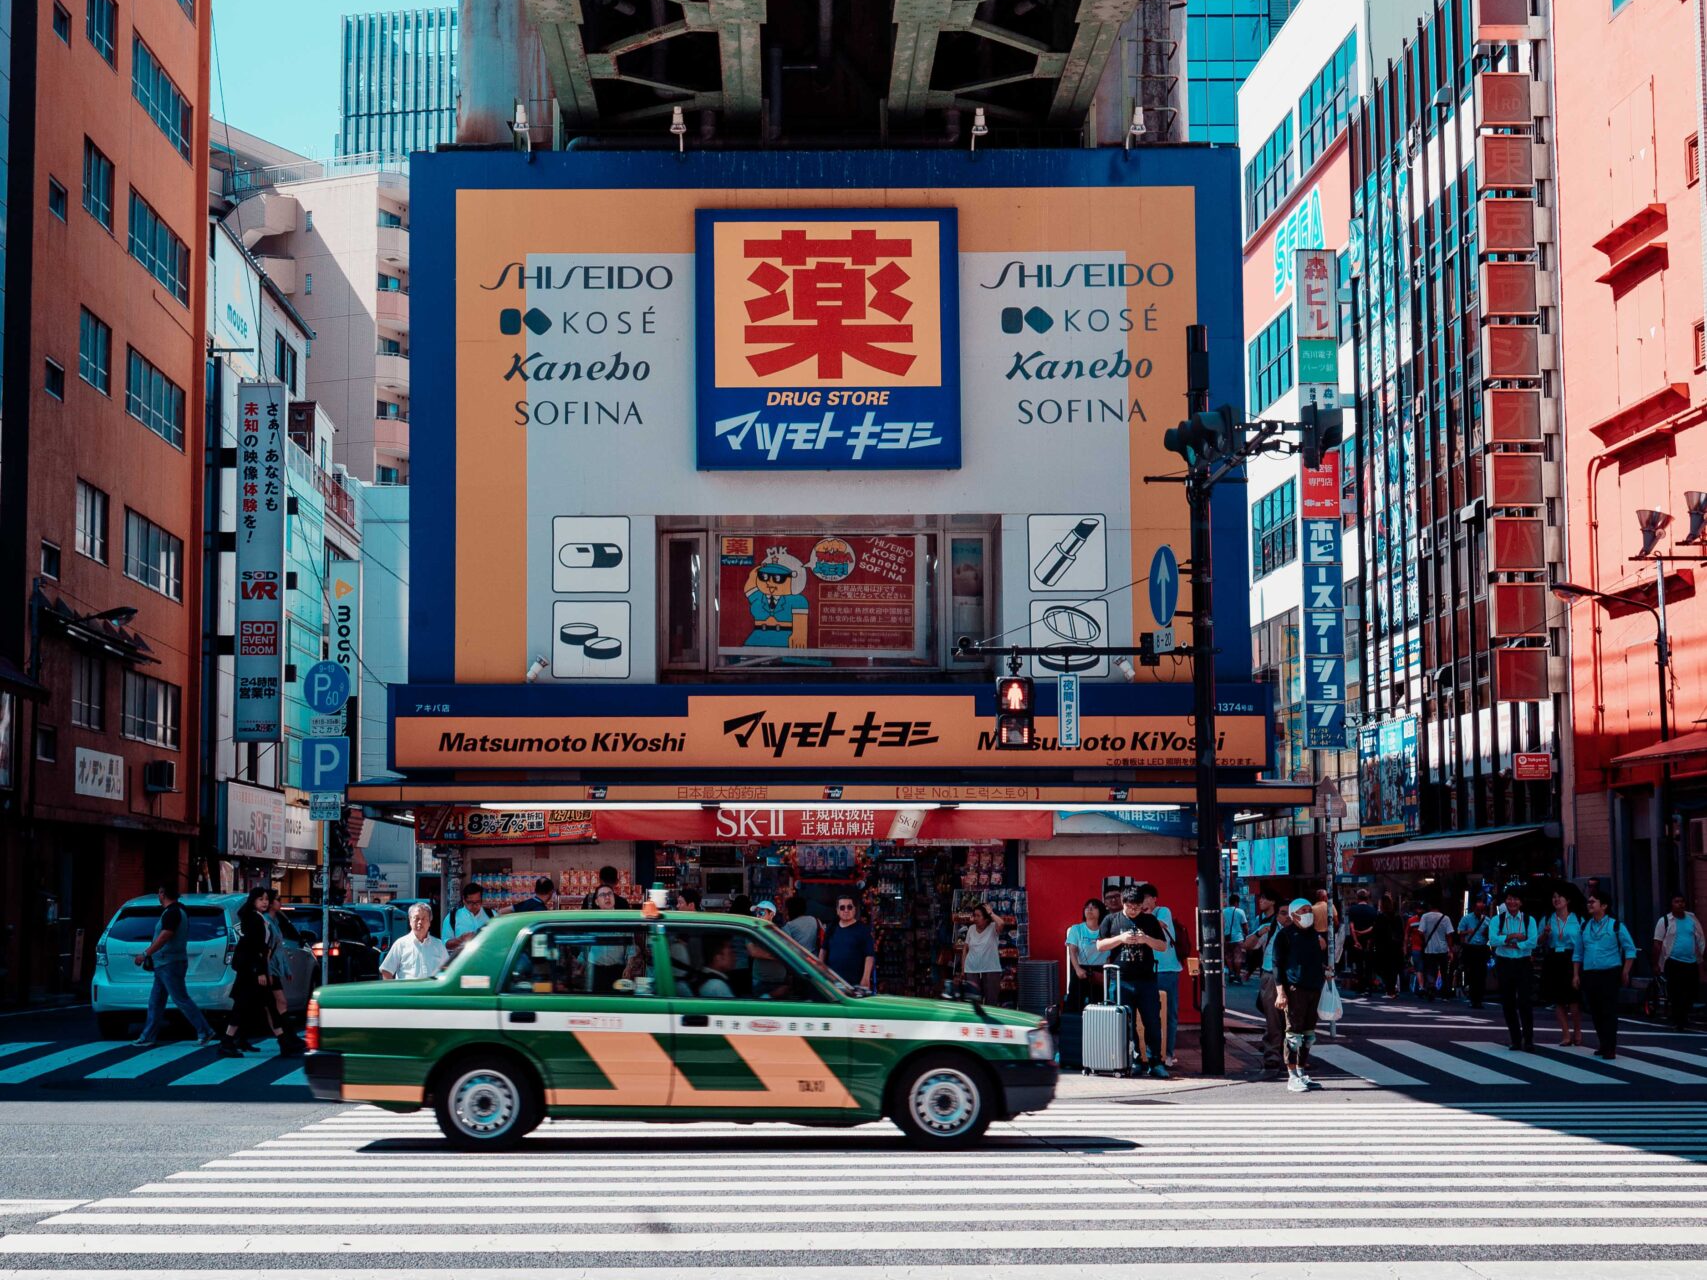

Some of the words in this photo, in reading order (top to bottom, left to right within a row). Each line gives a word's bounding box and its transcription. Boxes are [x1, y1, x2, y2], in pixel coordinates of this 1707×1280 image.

[1275, 187, 1324, 297] SEGA
[479, 262, 674, 291] SHISEIDO
[980, 260, 1175, 289] SHISEIDO
[743, 229, 918, 380] 薬
[1304, 257, 1329, 331] 森ビル
[226, 303, 248, 339] mouse
[563, 306, 657, 335] KOSÉ
[1064, 304, 1159, 333] KOSÉ
[503, 352, 651, 384] Kanebo
[1005, 349, 1153, 382] Kanebo
[767, 391, 822, 407] DRUG
[829, 391, 890, 406] STORE
[514, 400, 643, 426] SOFINA
[1017, 398, 1147, 424] SOFINA
[714, 411, 943, 462] マツモトキヨシ
[1308, 464, 1333, 474] 空管
[766, 546, 788, 557] MK
[866, 537, 913, 558] SHISEIDO
[872, 548, 904, 565] KOSÉ
[859, 562, 903, 582] SOFINA
[861, 553, 907, 574] Kanebo
[241, 571, 278, 580] SOD
[241, 581, 278, 600] VR
[242, 623, 275, 634] SOD
[1309, 521, 1338, 727] ホビーステーション
[242, 636, 275, 644] EVENT
[242, 646, 274, 654] ROOM
[240, 677, 278, 687] 24時間
[314, 673, 331, 706] P
[325, 690, 339, 706] 60
[1063, 679, 1075, 703] 夜間
[239, 687, 276, 699] 営業中
[415, 703, 450, 712] アキバ店
[439, 732, 587, 753] Matsumoto
[591, 731, 685, 753] KiYoshi
[723, 710, 940, 759] マツモトキヨシ
[1131, 732, 1226, 751] KiYosi
[314, 744, 340, 786] P
[1147, 758, 1164, 766] LED
[678, 786, 767, 800] 日本最大的药店
[931, 787, 958, 799] No.1
[800, 822, 875, 836] 正规品牌店
